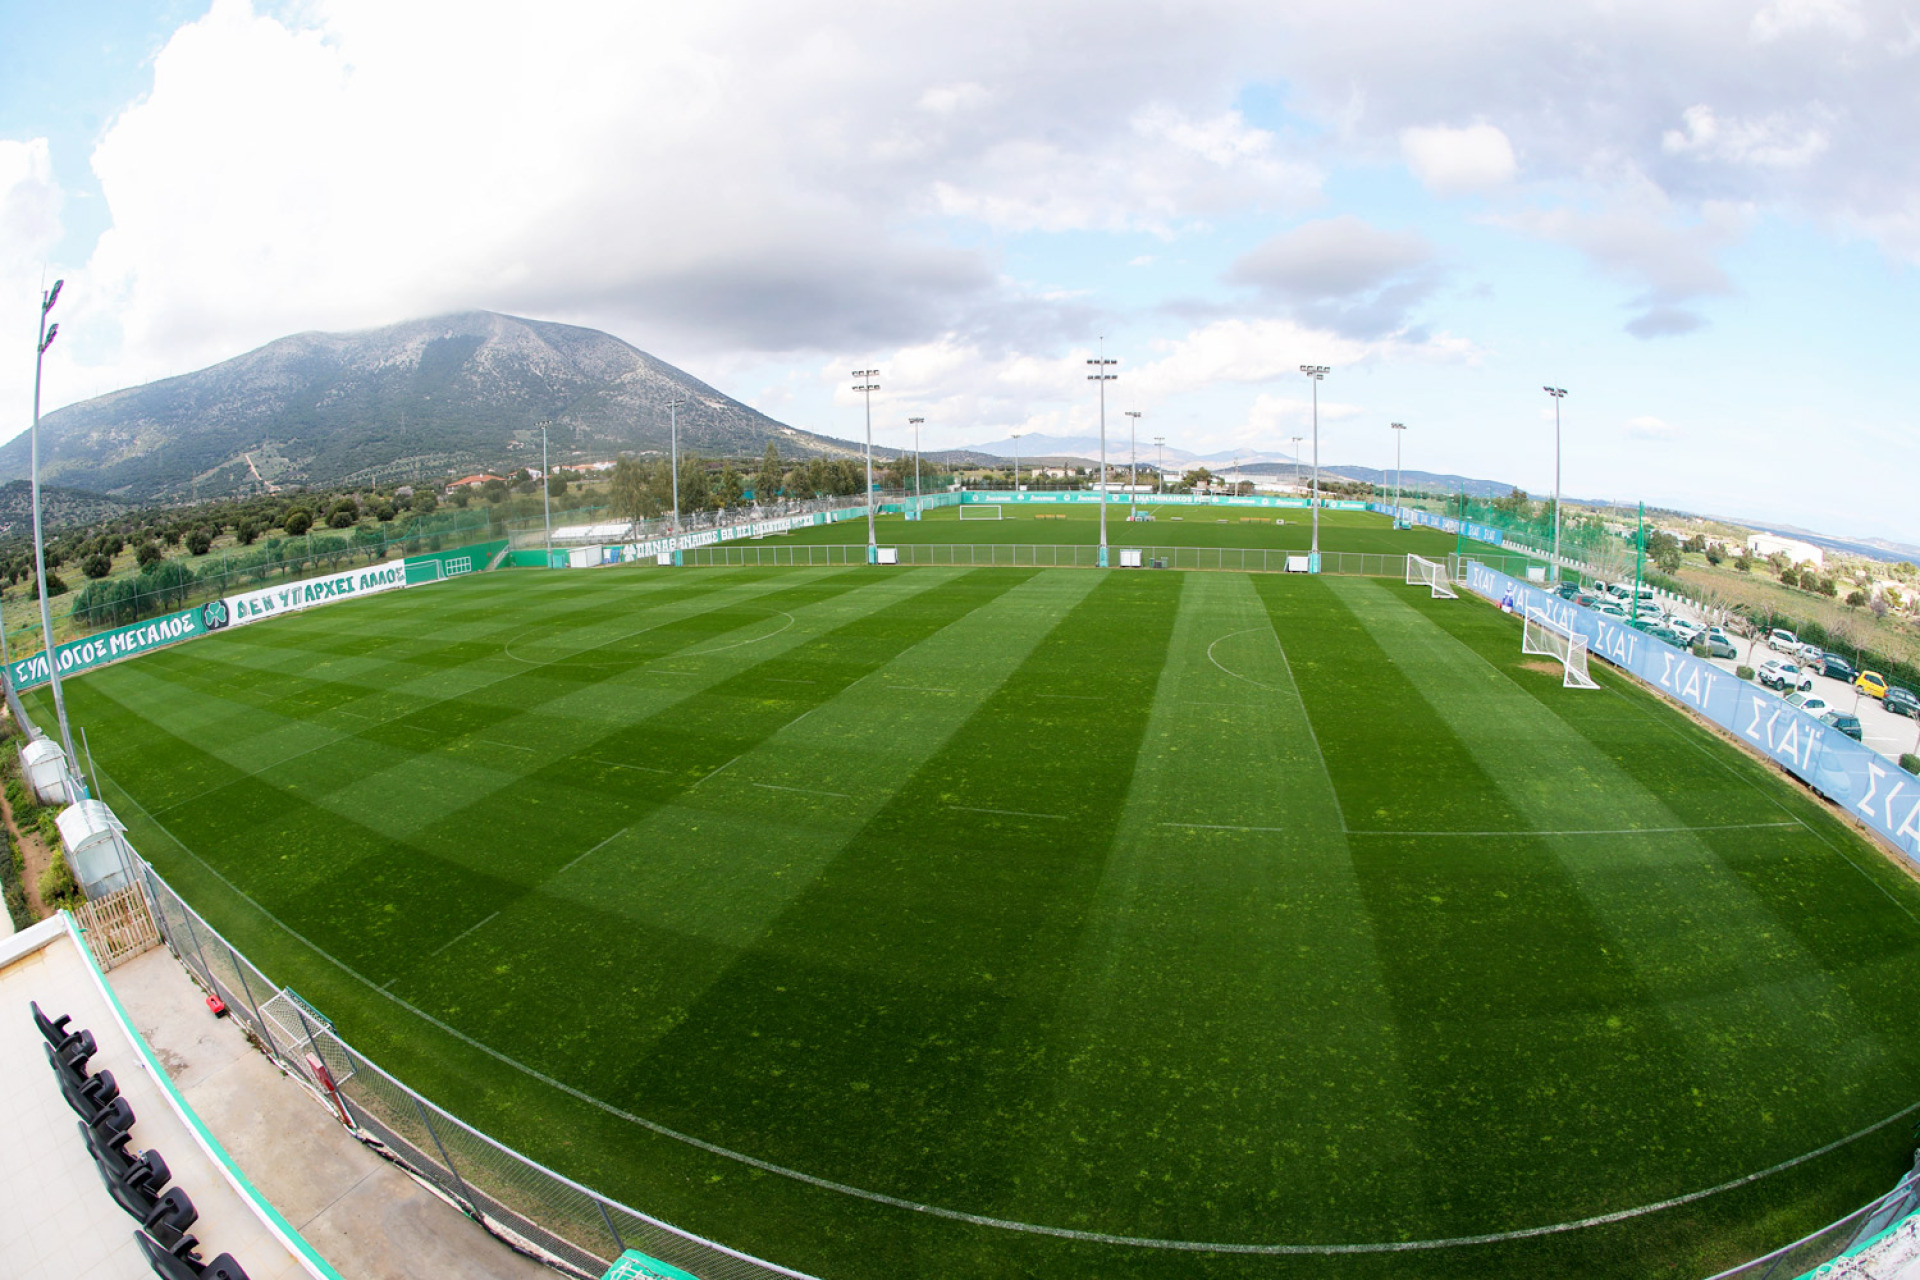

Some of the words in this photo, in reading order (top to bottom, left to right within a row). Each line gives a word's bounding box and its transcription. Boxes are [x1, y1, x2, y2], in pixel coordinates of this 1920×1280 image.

[237, 595, 275, 619] ΔΕΝ
[279, 575, 356, 608] ΥΠΑΡΧΕΙ
[359, 566, 405, 591] ΑΛΛΟΣ
[109, 613, 195, 655] ΜΕΓΑΛΟΣ
